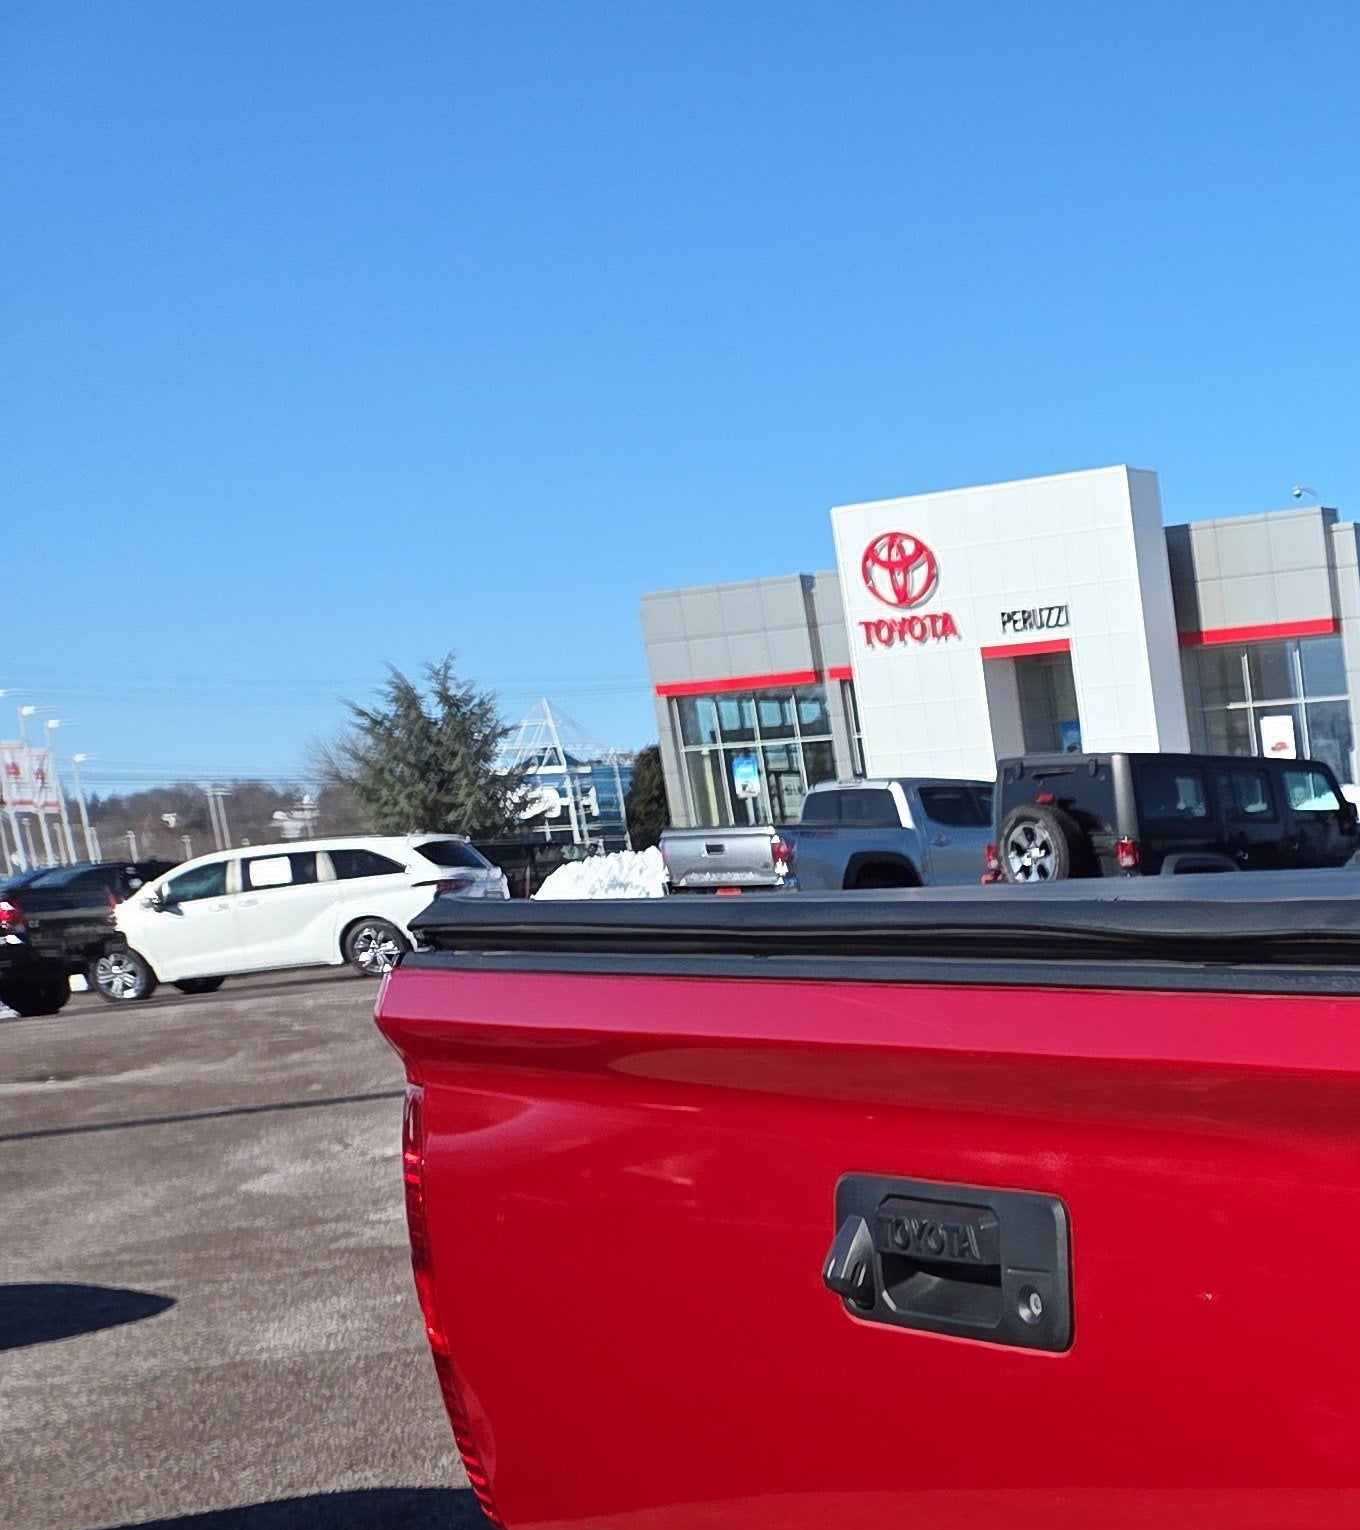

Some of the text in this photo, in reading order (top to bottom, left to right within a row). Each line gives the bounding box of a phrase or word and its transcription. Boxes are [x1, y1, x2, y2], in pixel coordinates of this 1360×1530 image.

[859, 612, 960, 647] TOYOTA
[1000, 604, 1071, 633] PERUZZI
[880, 1214, 982, 1261] TOYOTA
